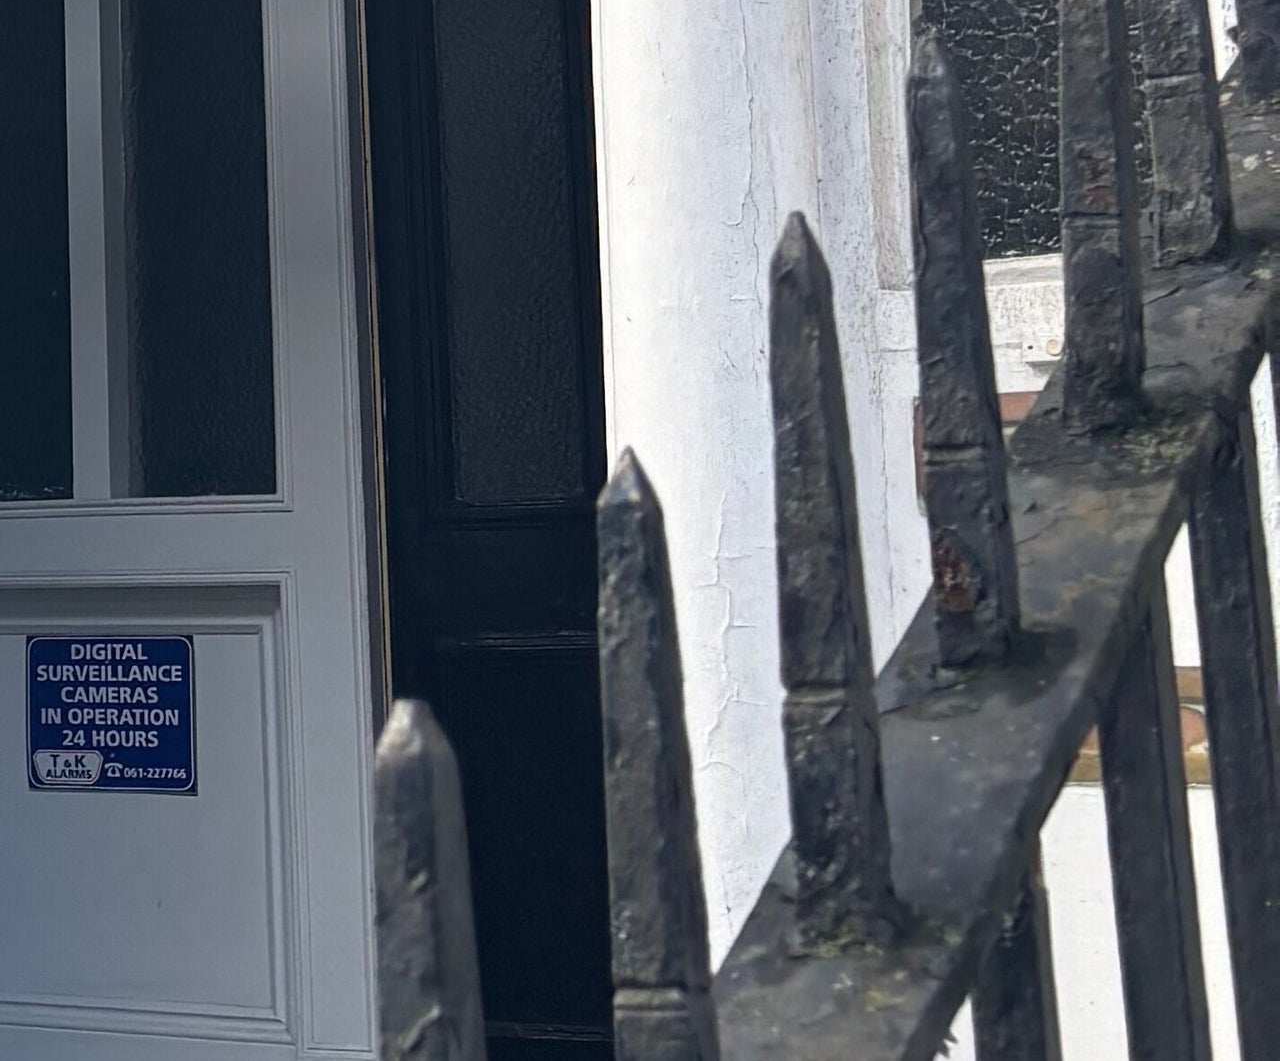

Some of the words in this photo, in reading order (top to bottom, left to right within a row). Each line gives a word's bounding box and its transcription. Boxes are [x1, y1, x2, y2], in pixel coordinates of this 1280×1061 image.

[71, 644, 148, 660] DIGITAL
[37, 665, 182, 682] SURVEILLANCE
[61, 686, 158, 703] CAMERAS
[41, 708, 61, 724] IN
[68, 708, 179, 726] OPERATION
[62, 730, 85, 746] 24
[92, 730, 158, 747] HOURS
[50, 754, 60, 768] T
[75, 754, 86, 768] K
[46, 767, 92, 780] ALARMS
